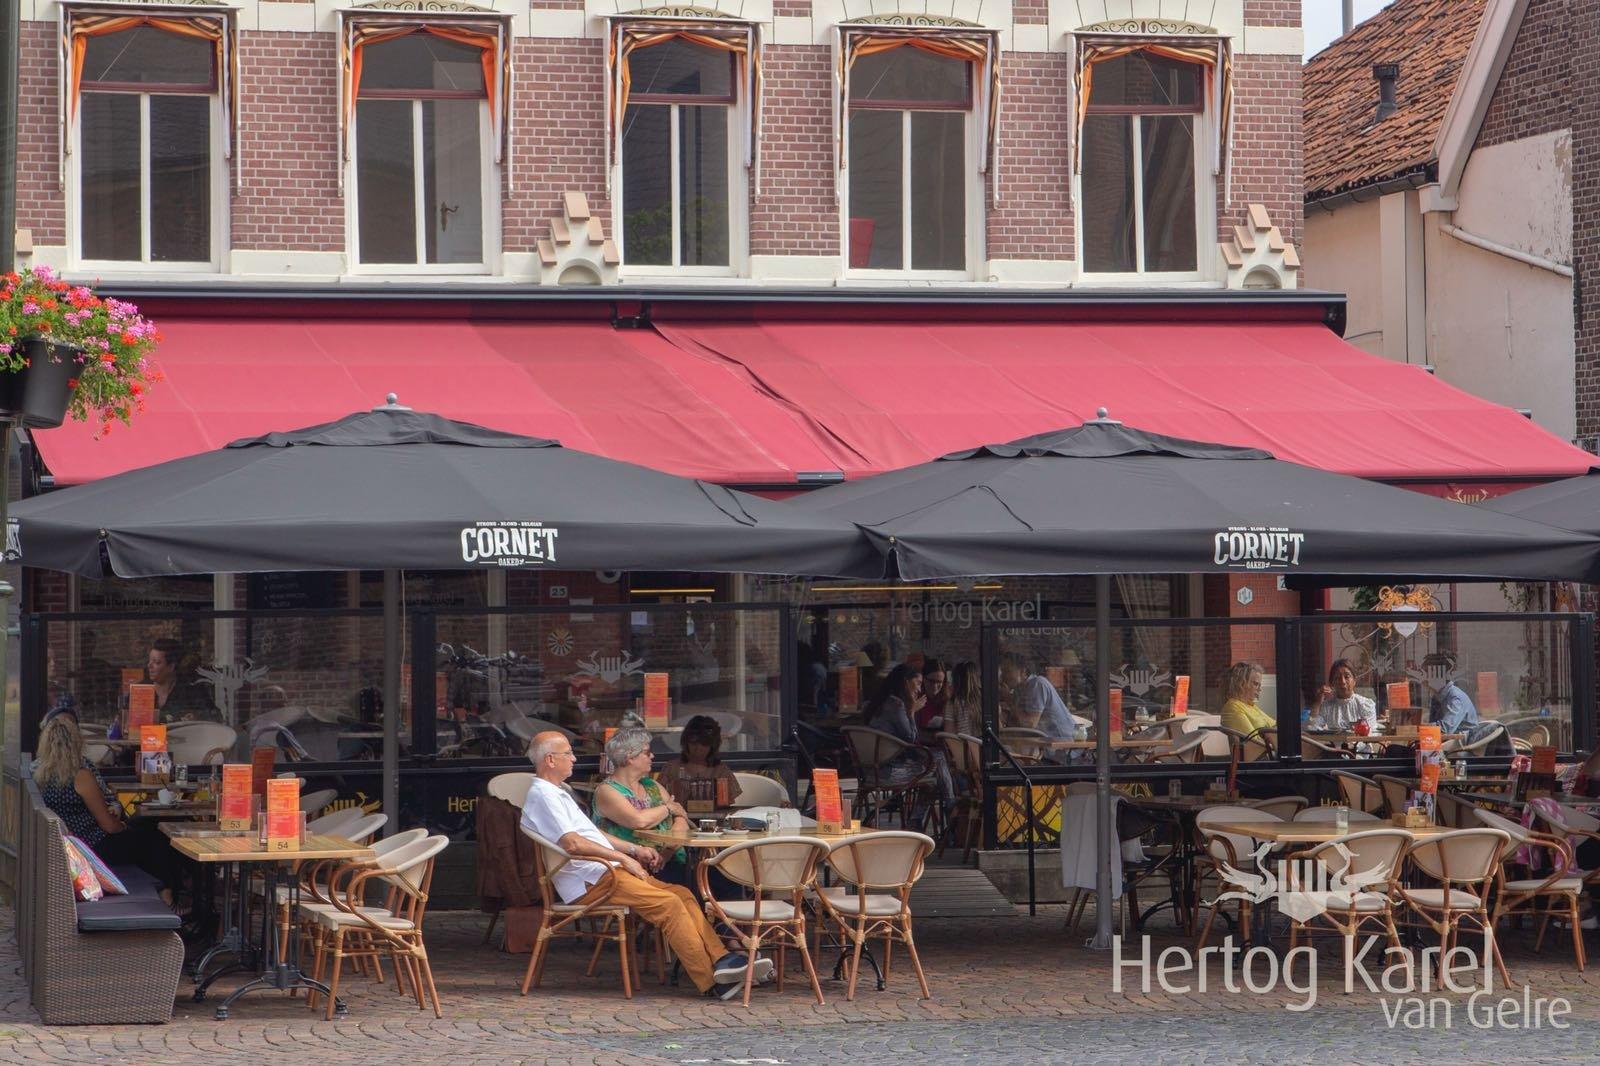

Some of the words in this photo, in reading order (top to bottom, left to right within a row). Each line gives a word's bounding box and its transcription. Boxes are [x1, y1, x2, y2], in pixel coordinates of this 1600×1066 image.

[461, 528, 558, 562] CORNET
[1214, 532, 1304, 565] CORNET
[890, 596, 972, 629] Hertog
[982, 593, 1041, 622] Karel
[230, 820, 241, 829] 53
[277, 841, 289, 850] 54
